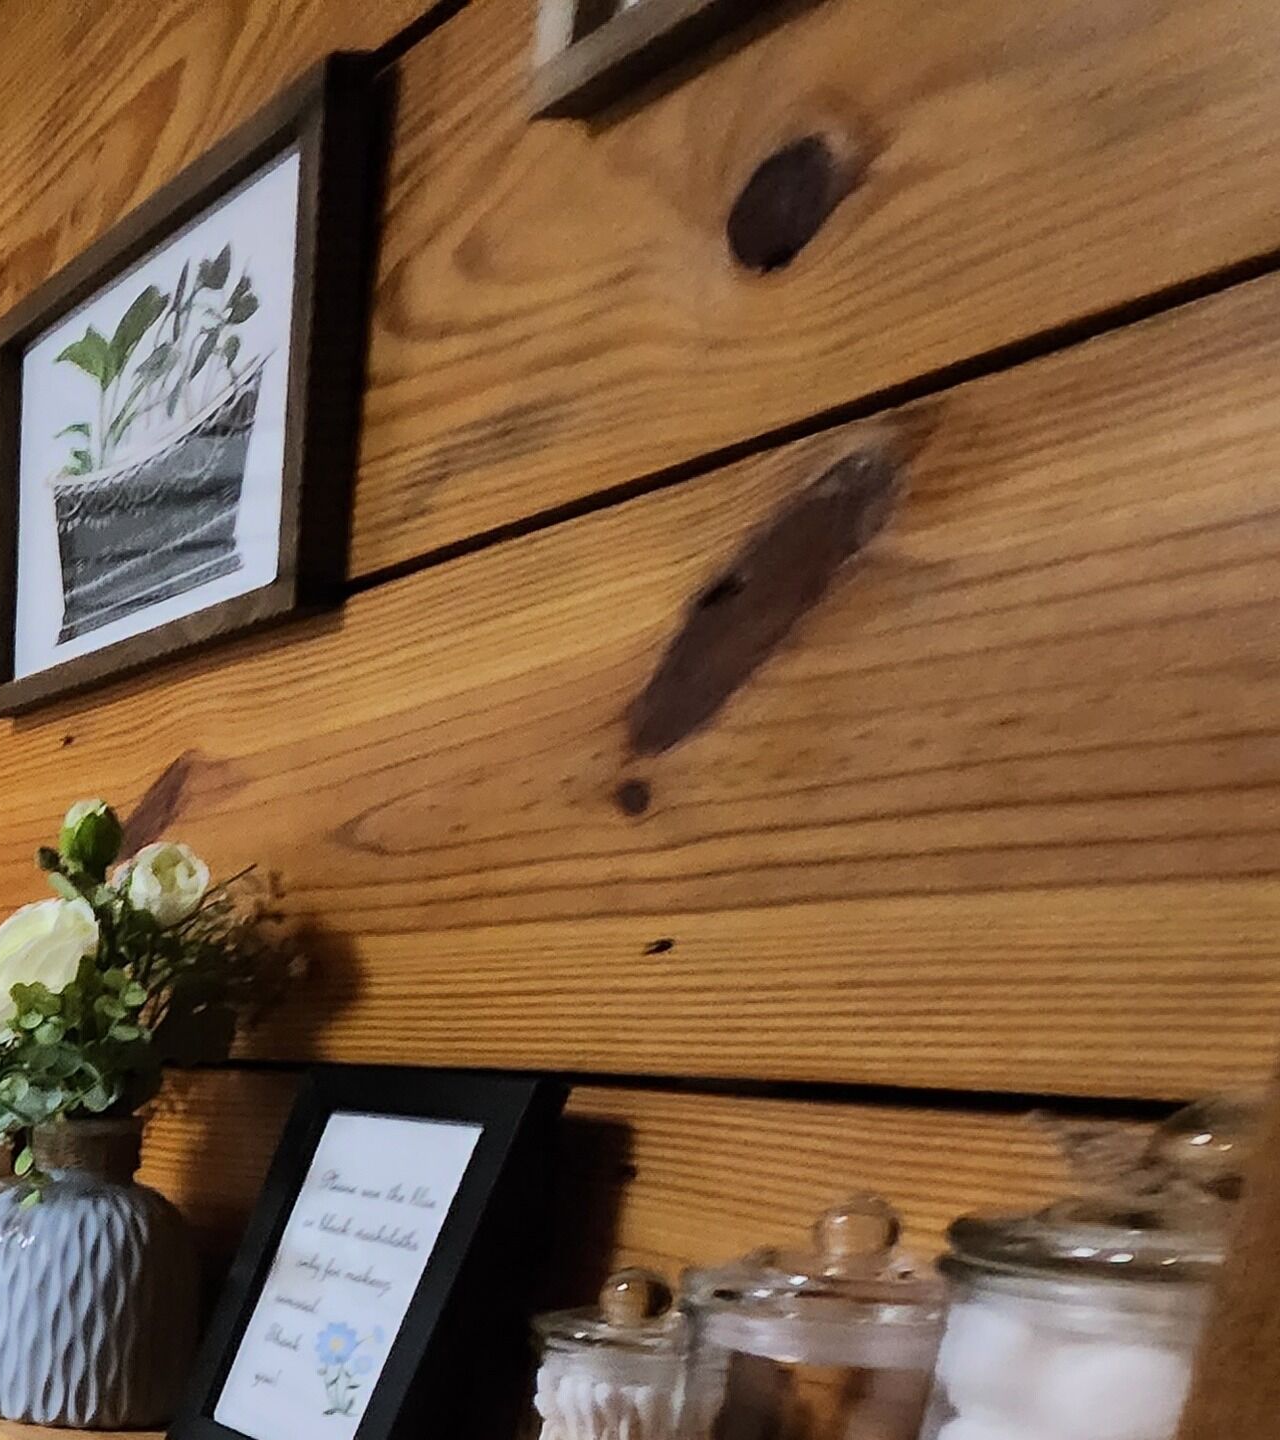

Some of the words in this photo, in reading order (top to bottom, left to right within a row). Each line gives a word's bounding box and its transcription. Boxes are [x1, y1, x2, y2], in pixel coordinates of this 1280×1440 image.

[322, 1170, 359, 1195] Please
[386, 1183, 405, 1203] the
[321, 1257, 342, 1282] for
